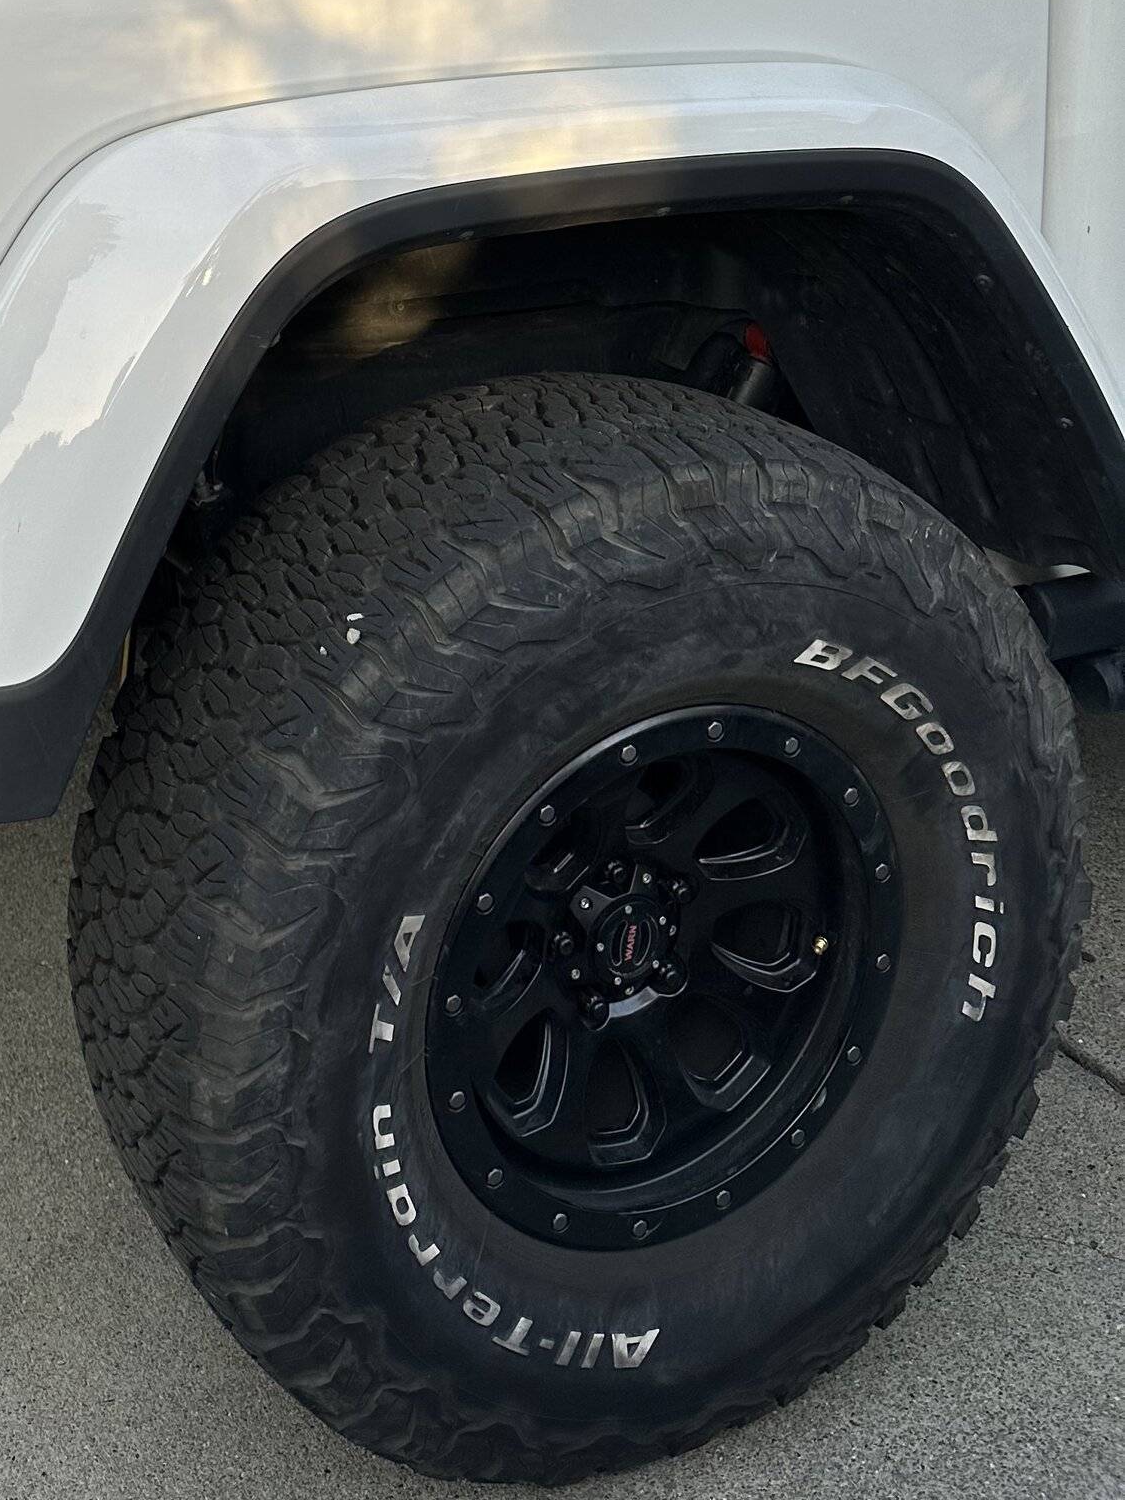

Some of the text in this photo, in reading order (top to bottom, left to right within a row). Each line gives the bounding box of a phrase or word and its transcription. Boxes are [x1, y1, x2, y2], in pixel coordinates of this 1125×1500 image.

[624, 924, 637, 962] WARN
[793, 638, 1007, 1023] BFGoodrich
[368, 913, 662, 1370] All-Terrain T/A
